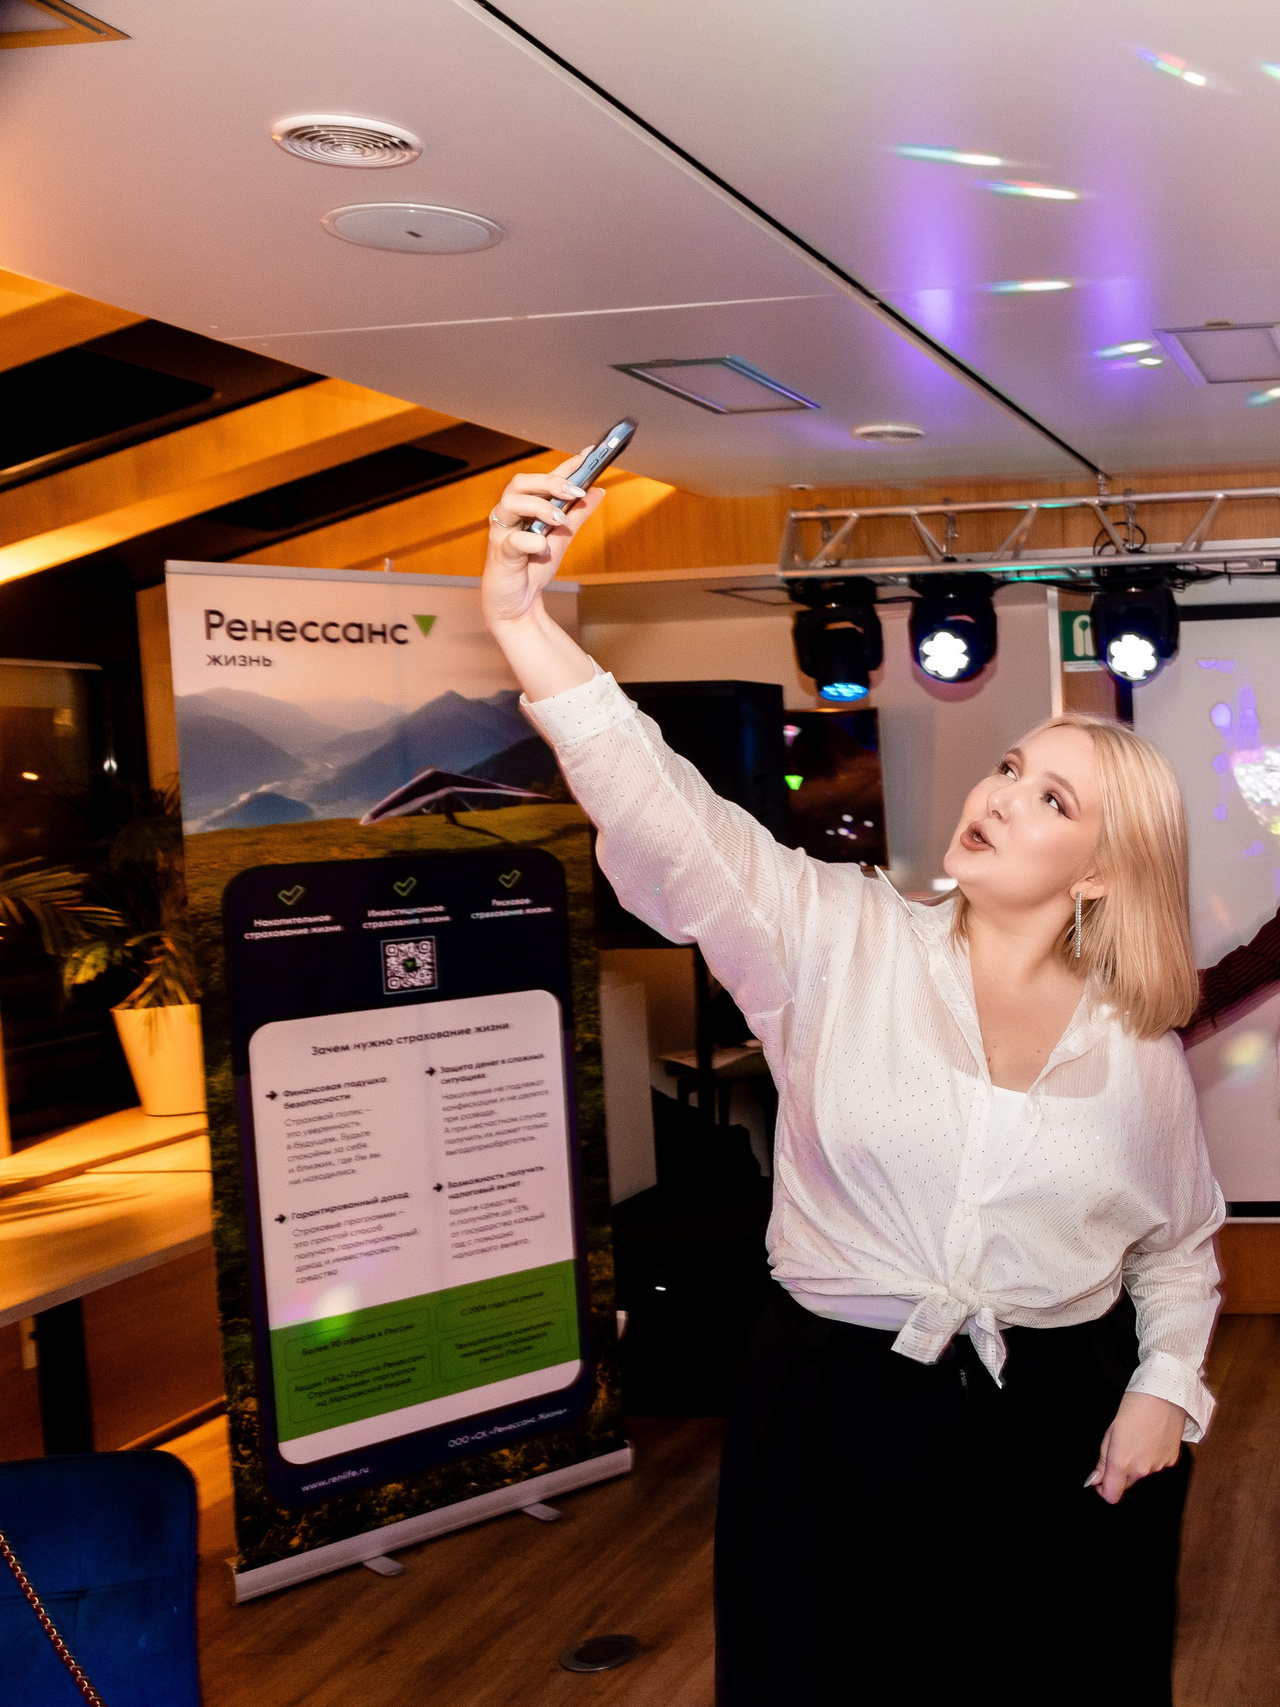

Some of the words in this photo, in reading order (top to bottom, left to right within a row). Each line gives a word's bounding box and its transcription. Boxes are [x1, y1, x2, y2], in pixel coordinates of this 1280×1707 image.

[204, 609, 409, 645] Ренессанс
[205, 654, 273, 667] жизнь
[253, 915, 331, 927] Накопительное
[470, 909, 524, 920] страхование
[362, 918, 420, 929] страхование
[244, 928, 309, 940] страхование
[311, 925, 342, 933] жизни
[311, 1044, 350, 1056] Зачем
[353, 1038, 393, 1051] нужно
[396, 1028, 471, 1046] страхование
[440, 1064, 473, 1074] Защита
[475, 1060, 498, 1069] денег
[508, 1054, 544, 1063] сложных
[440, 1073, 486, 1084] ситуациях
[283, 1084, 341, 1097] Финансовая
[344, 1077, 386, 1088] подушка
[284, 1094, 350, 1109] безопасности
[448, 1174, 504, 1188] Возможность
[506, 1166, 544, 1177] получить
[448, 1185, 494, 1199] налоговый
[291, 1196, 378, 1220] Гарантированный
[380, 1192, 410, 1203] доход
[448, 1436, 470, 1448] ООО
[301, 1467, 369, 1492] www.renlife.ru
